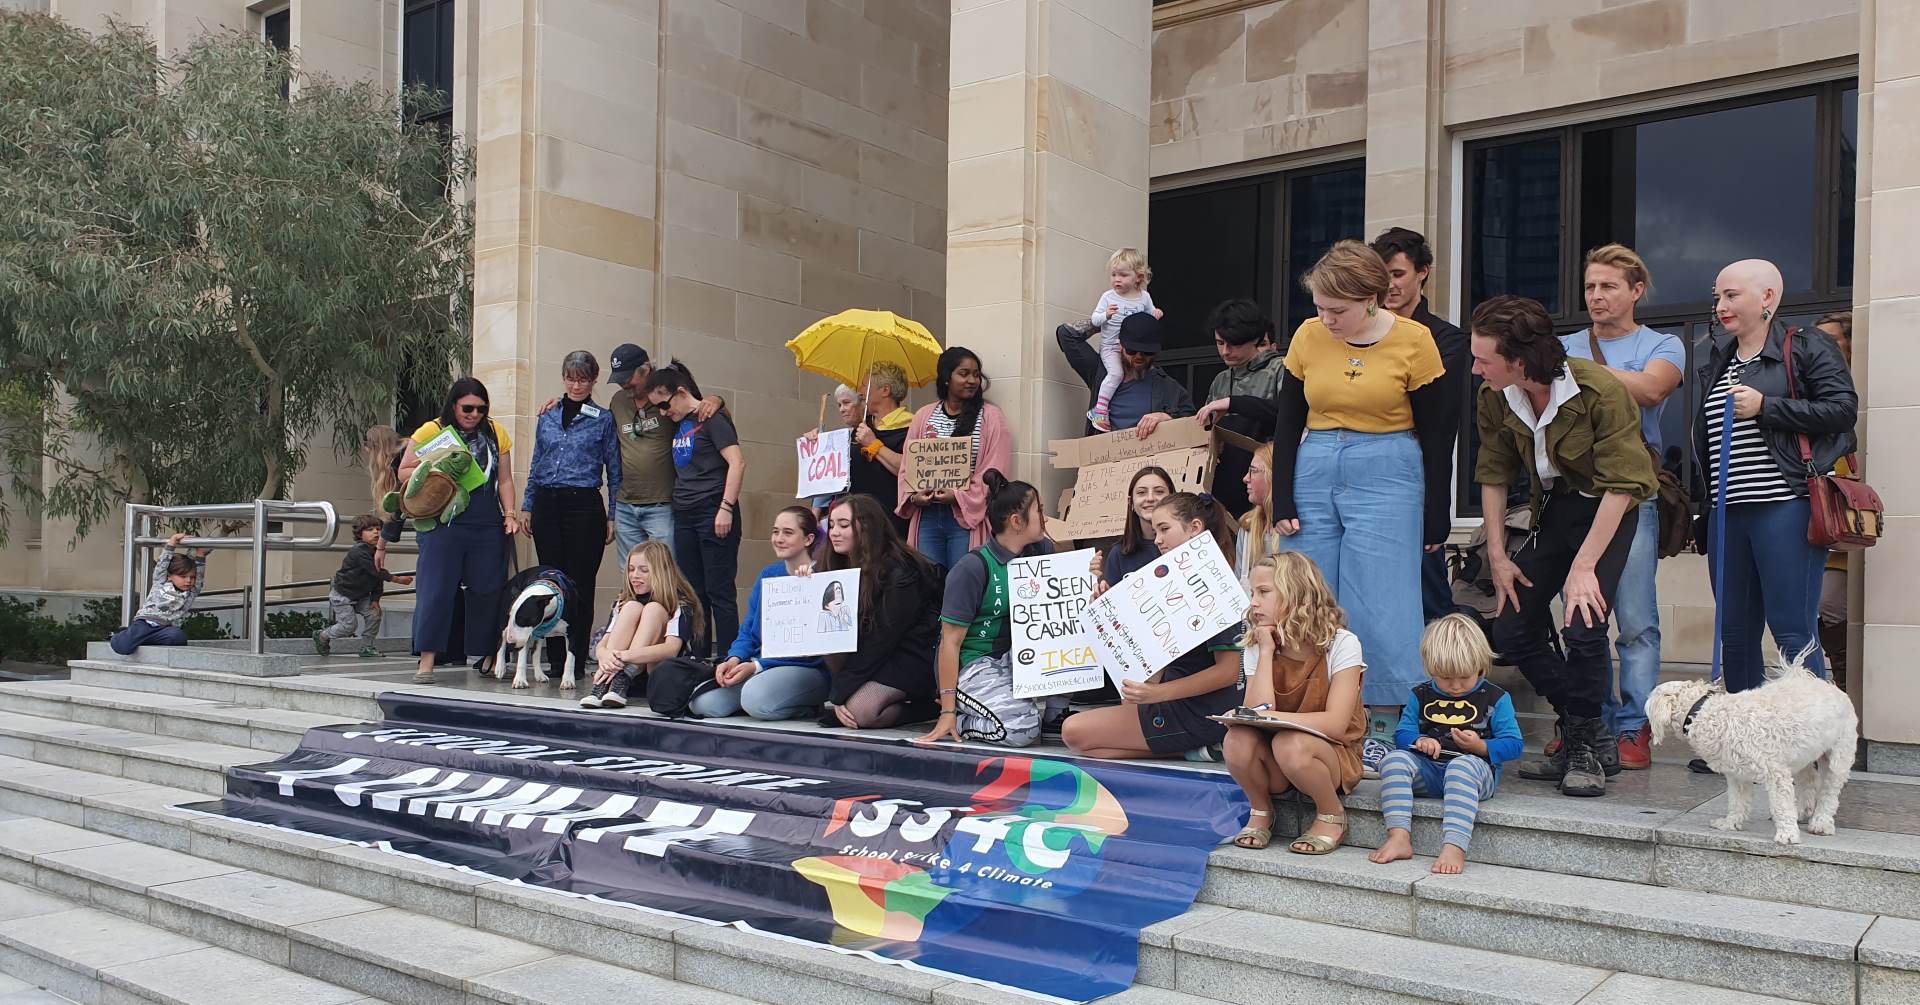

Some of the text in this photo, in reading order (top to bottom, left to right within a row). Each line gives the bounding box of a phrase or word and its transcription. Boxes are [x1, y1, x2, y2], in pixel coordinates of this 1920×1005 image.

[908, 441, 968, 454] CHANGE THE
[915, 453, 968, 467] POLICIES
[808, 451, 847, 481] COAL
[916, 468, 961, 478] NOT THE
[1046, 575, 1093, 599] SEEN
[1189, 532, 1244, 615] Be part of the
[979, 573, 1002, 638] LEAVRS
[1160, 580, 1191, 615] NOT
[1017, 646, 1097, 670] @ IKEA
[838, 844, 898, 861] School
[958, 861, 970, 874] 4
[977, 865, 1053, 889] Climate
